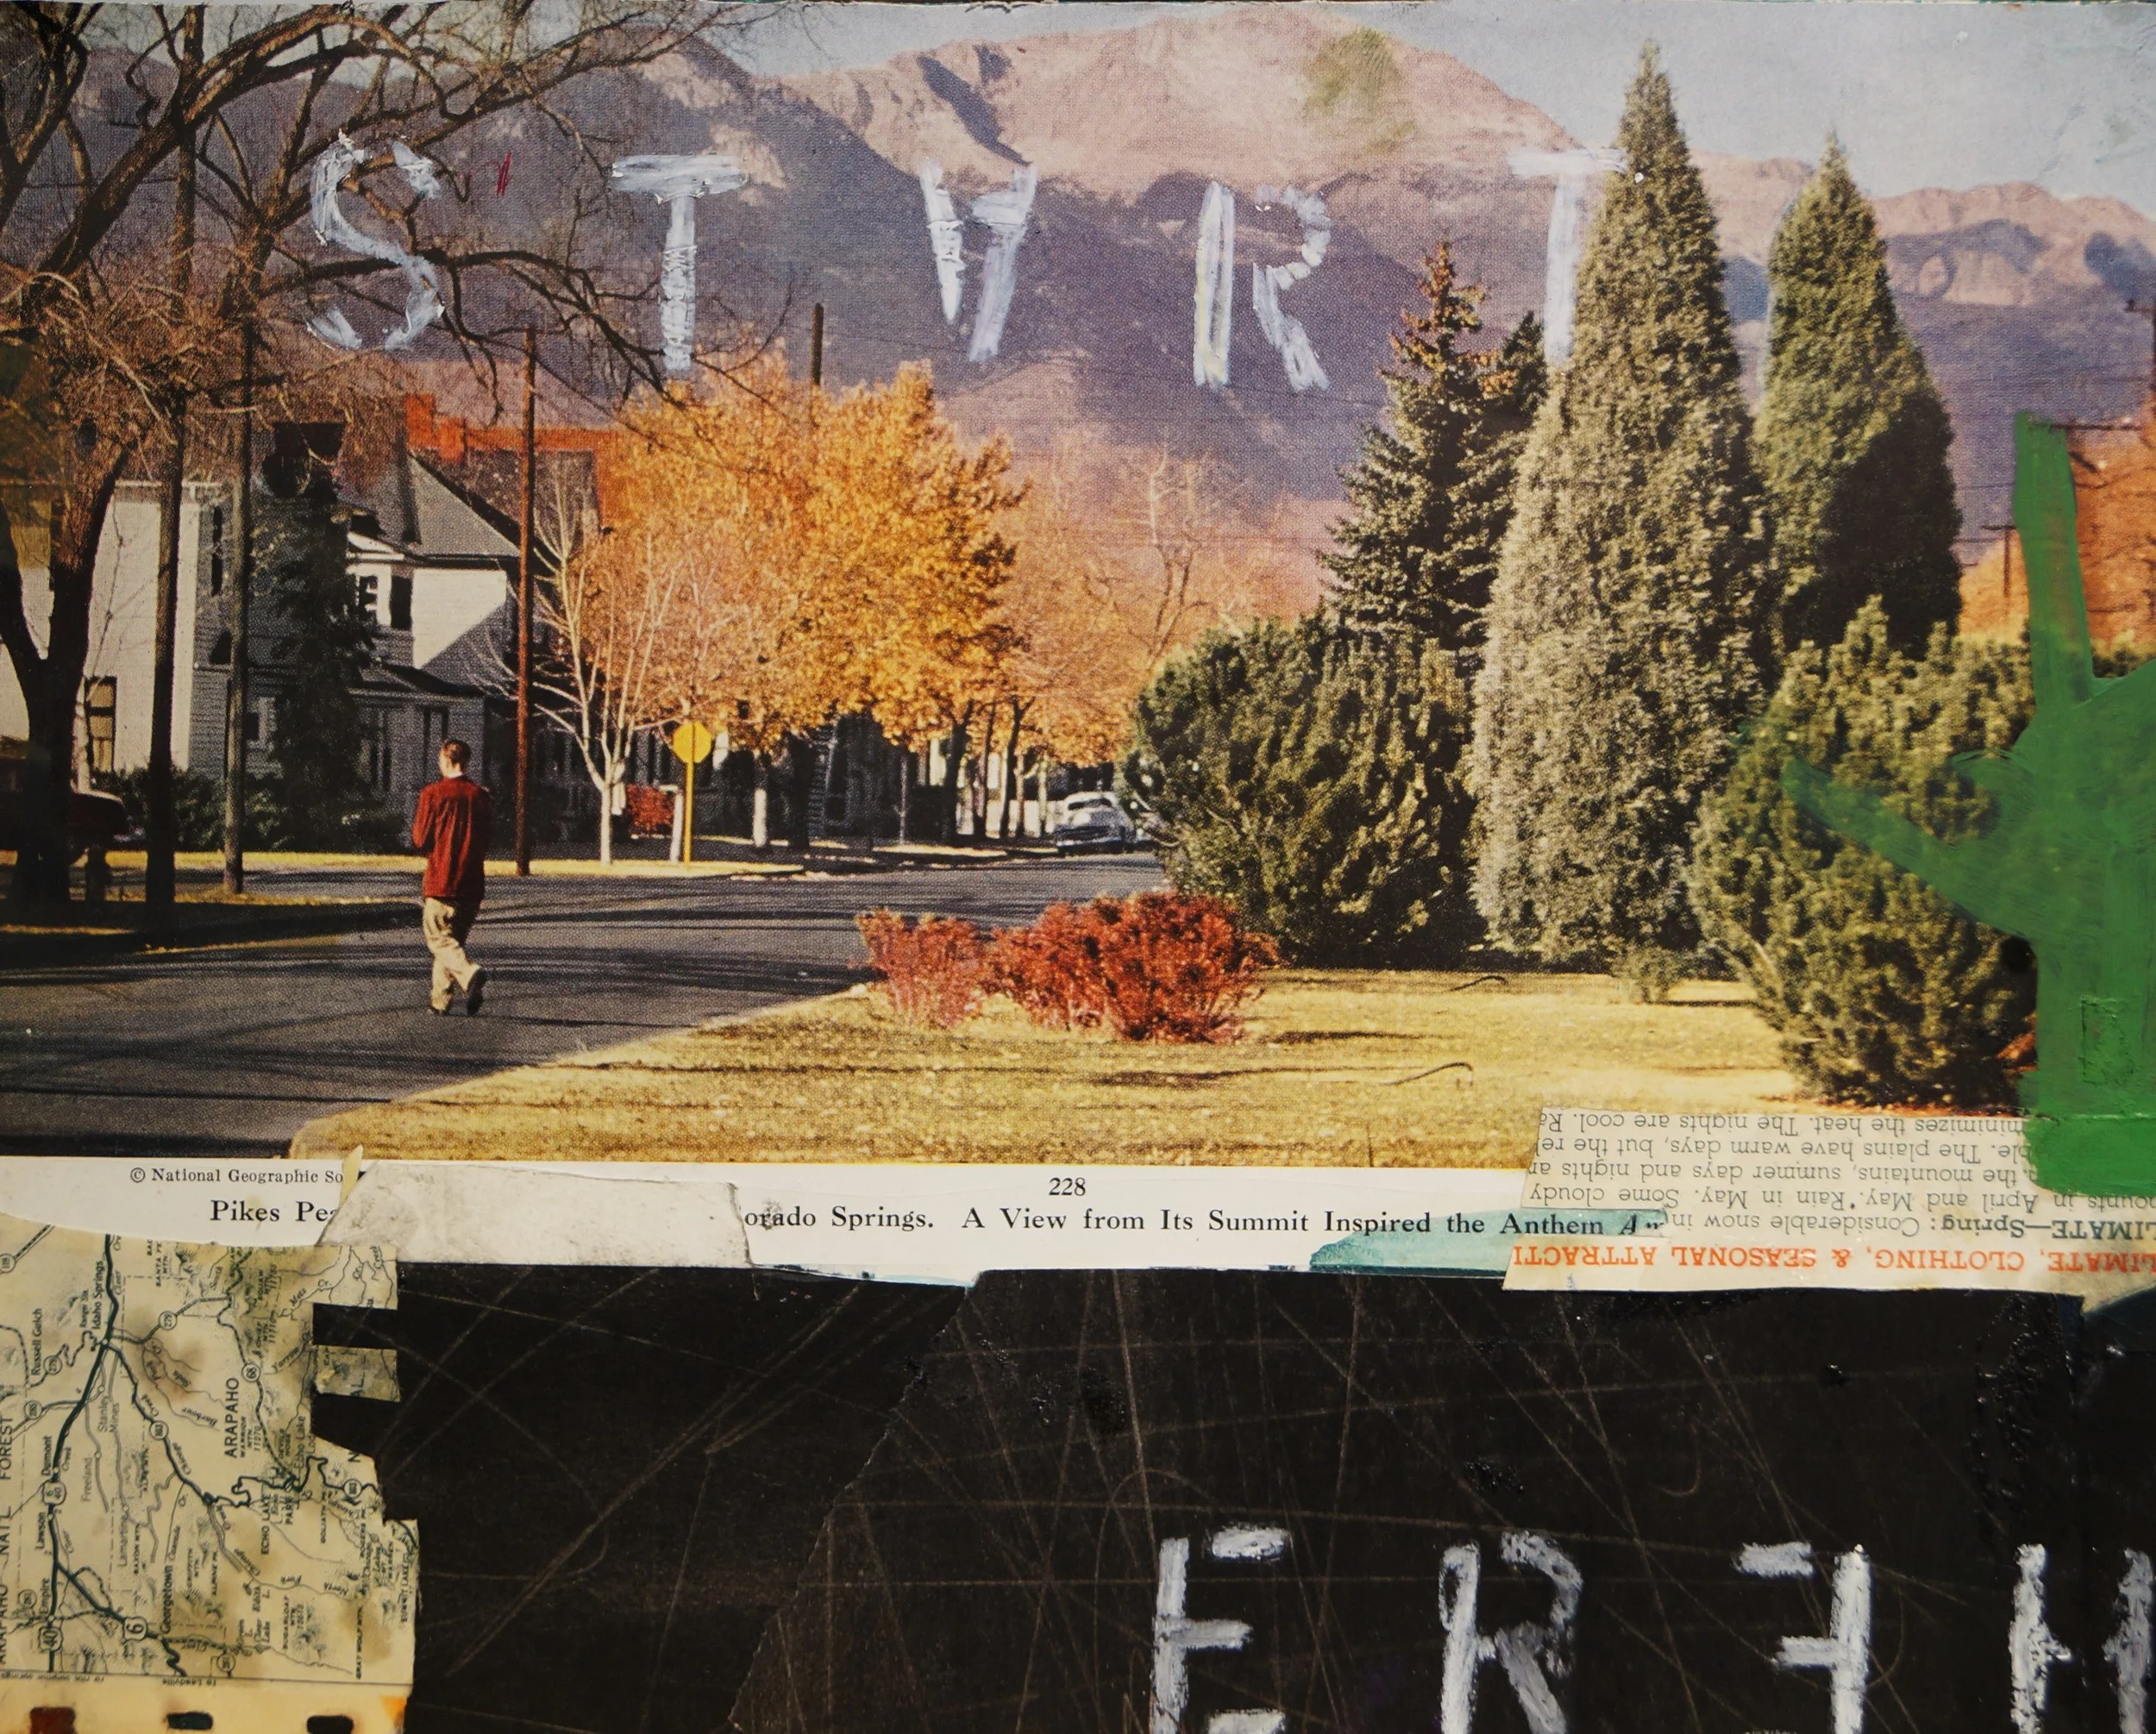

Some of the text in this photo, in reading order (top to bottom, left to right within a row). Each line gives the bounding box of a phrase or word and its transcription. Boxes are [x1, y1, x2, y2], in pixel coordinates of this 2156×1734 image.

[1573, 1114, 1625, 1133] cool.
[1634, 1114, 1670, 1129] are
[1680, 1114, 1747, 1134] nights
[1758, 1117, 1798, 1136] The
[1809, 1117, 1862, 1135] heat.
[1871, 1117, 1905, 1136] the
[1915, 1118, 2023, 1136] minimizes
[1575, 1138, 1608, 1157] the
[1618, 1138, 1653, 1158] but
[1664, 1136, 1720, 1159] days,
[1732, 1140, 1790, 1155] warm
[1801, 1142, 1852, 1161] have
[1864, 1140, 1928, 1161] plains
[1940, 1143, 1980, 1162] The
[151, 1167, 221, 1182] National
[228, 1168, 318, 1184] Geographic
[324, 1169, 343, 1184] So
[1562, 1159, 1637, 1181] nights
[1640, 1163, 1682, 1183] and
[1693, 1161, 1742, 1185] days
[1752, 1166, 1840, 1180] summer
[1852, 1166, 1972, 1186] mountains,
[1984, 1169, 2016, 1188] the
[1048, 1177, 1087, 1197] 228
[1530, 1183, 1604, 1206] cloudy
[1619, 1188, 1678, 1206] Some
[1695, 1186, 1747, 1208] May.
[1762, 1190, 1783, 1207] in
[1796, 1191, 1845, 1211] Rain
[1859, 1188, 1912, 1211] May.
[1927, 1192, 1968, 1211] and
[1983, 1190, 2038, 1212] April
[210, 1199, 280, 1222] Pikes
[830, 1205, 935, 1232] Springs.
[961, 1207, 985, 1229] A
[1000, 1207, 1068, 1230] View
[1083, 1208, 1145, 1230] from
[1160, 1209, 1194, 1230] Its
[1208, 1209, 1309, 1231] Summit
[1324, 1210, 1431, 1237] Inspired
[1446, 1212, 1486, 1234] the
[1499, 1213, 1604, 1235] Anthem
[1671, 1214, 1692, 1230] in
[1704, 1214, 1759, 1228] snow
[1770, 1214, 1920, 1236] Considerable
[1513, 1245, 1657, 1266] ATTRACTI
[1671, 1246, 1816, 1268] SEASONAL
[1831, 1249, 1852, 1268] &
[1865, 1247, 2024, 1271] CLOTHING,
[91, 1261, 105, 1330] Idaho Springs
[164, 1313, 172, 1328] 279
[31, 1308, 41, 1375] Russell Gulch
[247, 1368, 255, 1380] 68
[98, 1396, 110, 1431] Stanley
[110, 1402, 120, 1432] Mines
[224, 1378, 240, 1459] ARAPAHO
[0, 1417, 12, 1480] FOREST
[294, 1416, 305, 1468] Echo Lake
[41, 1435, 52, 1476] Dumont
[81, 1457, 92, 1502] Freeland
[285, 1496, 293, 1525] PARK
[35, 1512, 45, 1550] Lawson
[260, 1493, 271, 1554] ECHO LAKE
[117, 1514, 129, 1568] Lamartine
[40, 1578, 52, 1614] Empire
[160, 1564, 174, 1634] Georgetown
[43, 1631, 58, 1647] 40
[126, 1624, 144, 1634] 6
